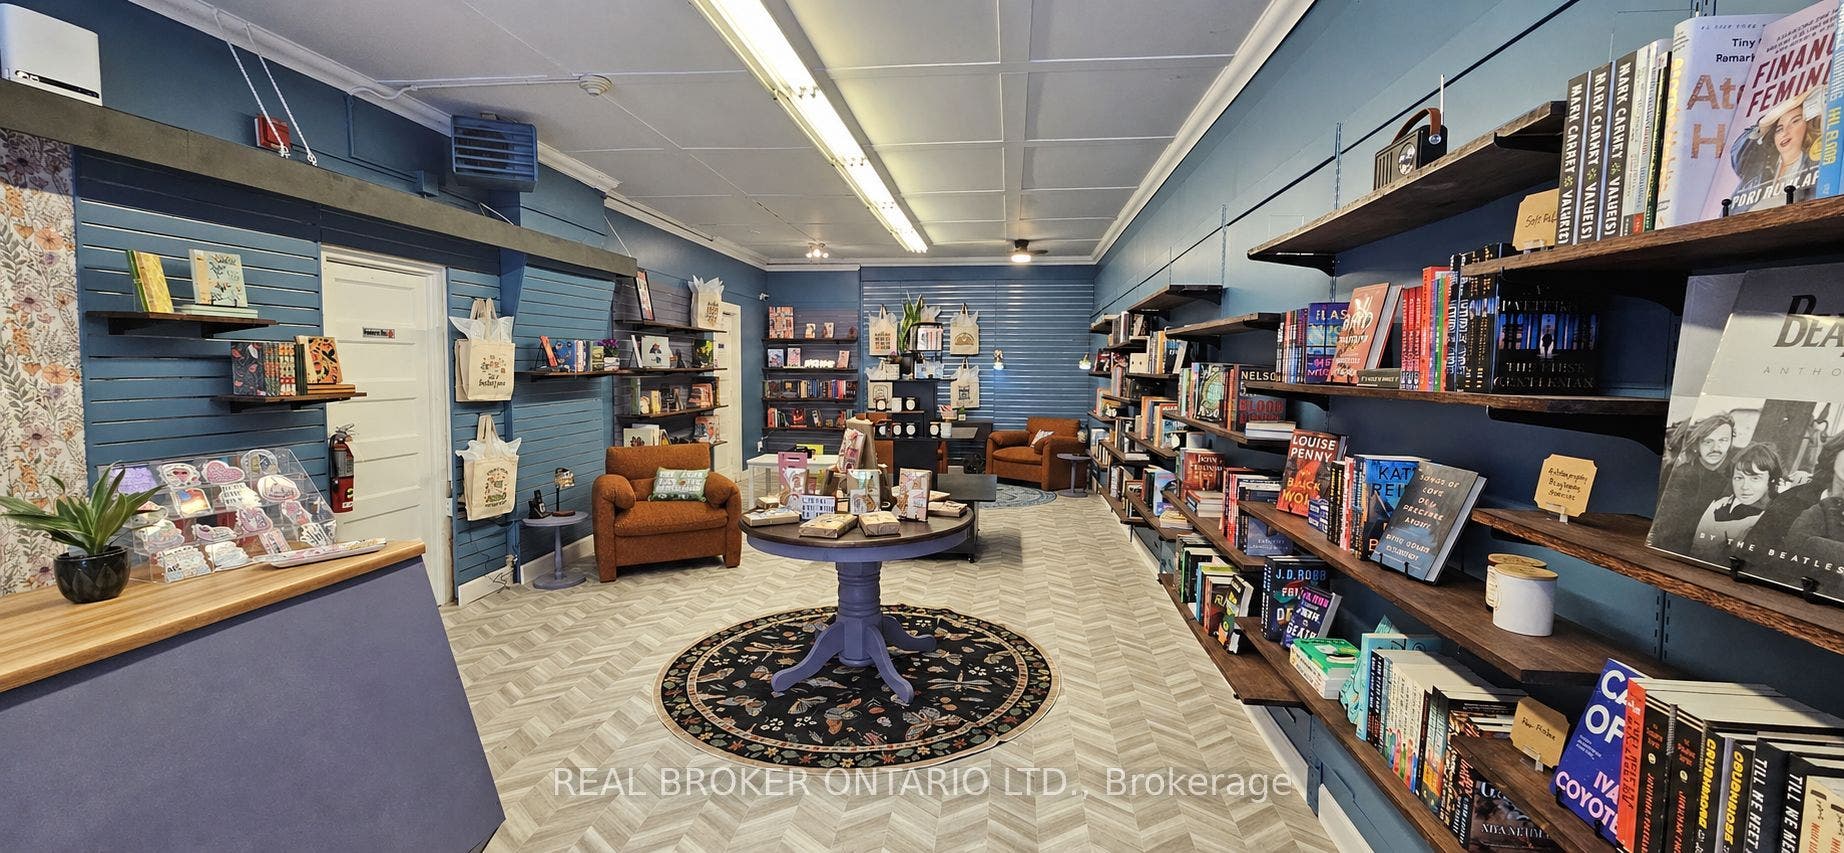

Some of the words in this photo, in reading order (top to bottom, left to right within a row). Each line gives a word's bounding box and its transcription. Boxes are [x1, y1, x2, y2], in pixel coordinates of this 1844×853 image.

[1732, 38, 1755, 50] Tiny
[1590, 71, 1607, 109] MARK
[1617, 62, 1631, 104] MARK
[1569, 83, 1583, 122] MARK
[1762, 365, 1842, 377] ANTHO
[1290, 447, 1333, 463] PENNY
[1292, 435, 1336, 450] LOUISE
[1378, 467, 1416, 481] KAT
[1700, 532, 1716, 541] BY
[1727, 538, 1756, 552] THE
[1768, 548, 1844, 575] BEATLES
[1298, 569, 1327, 581] ROBB
[1585, 704, 1626, 744] OF
[1753, 757, 1768, 785] TILL
[1787, 773, 1803, 802] TILL
[1747, 812, 1762, 850] MEET
[1784, 805, 1799, 830] WE
